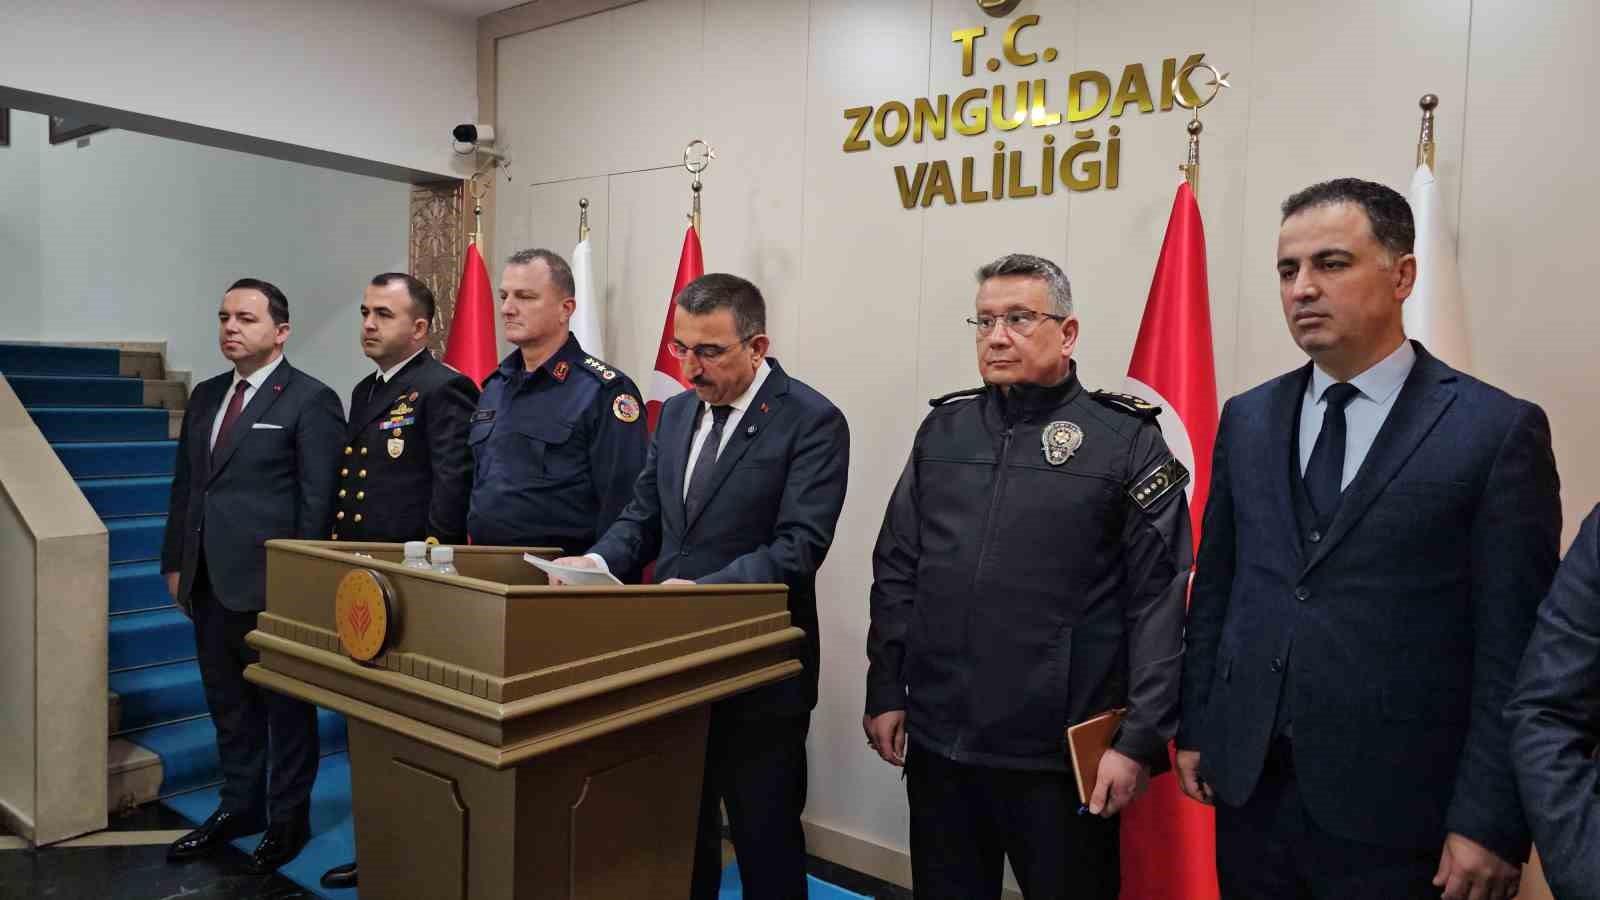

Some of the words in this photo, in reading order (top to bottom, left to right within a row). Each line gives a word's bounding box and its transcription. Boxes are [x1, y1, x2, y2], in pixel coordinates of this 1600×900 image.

[952, 14, 1058, 77] T.C.
[842, 53, 1206, 152] ZONGULDAK
[894, 124, 1121, 209] VALİLİĞİ
